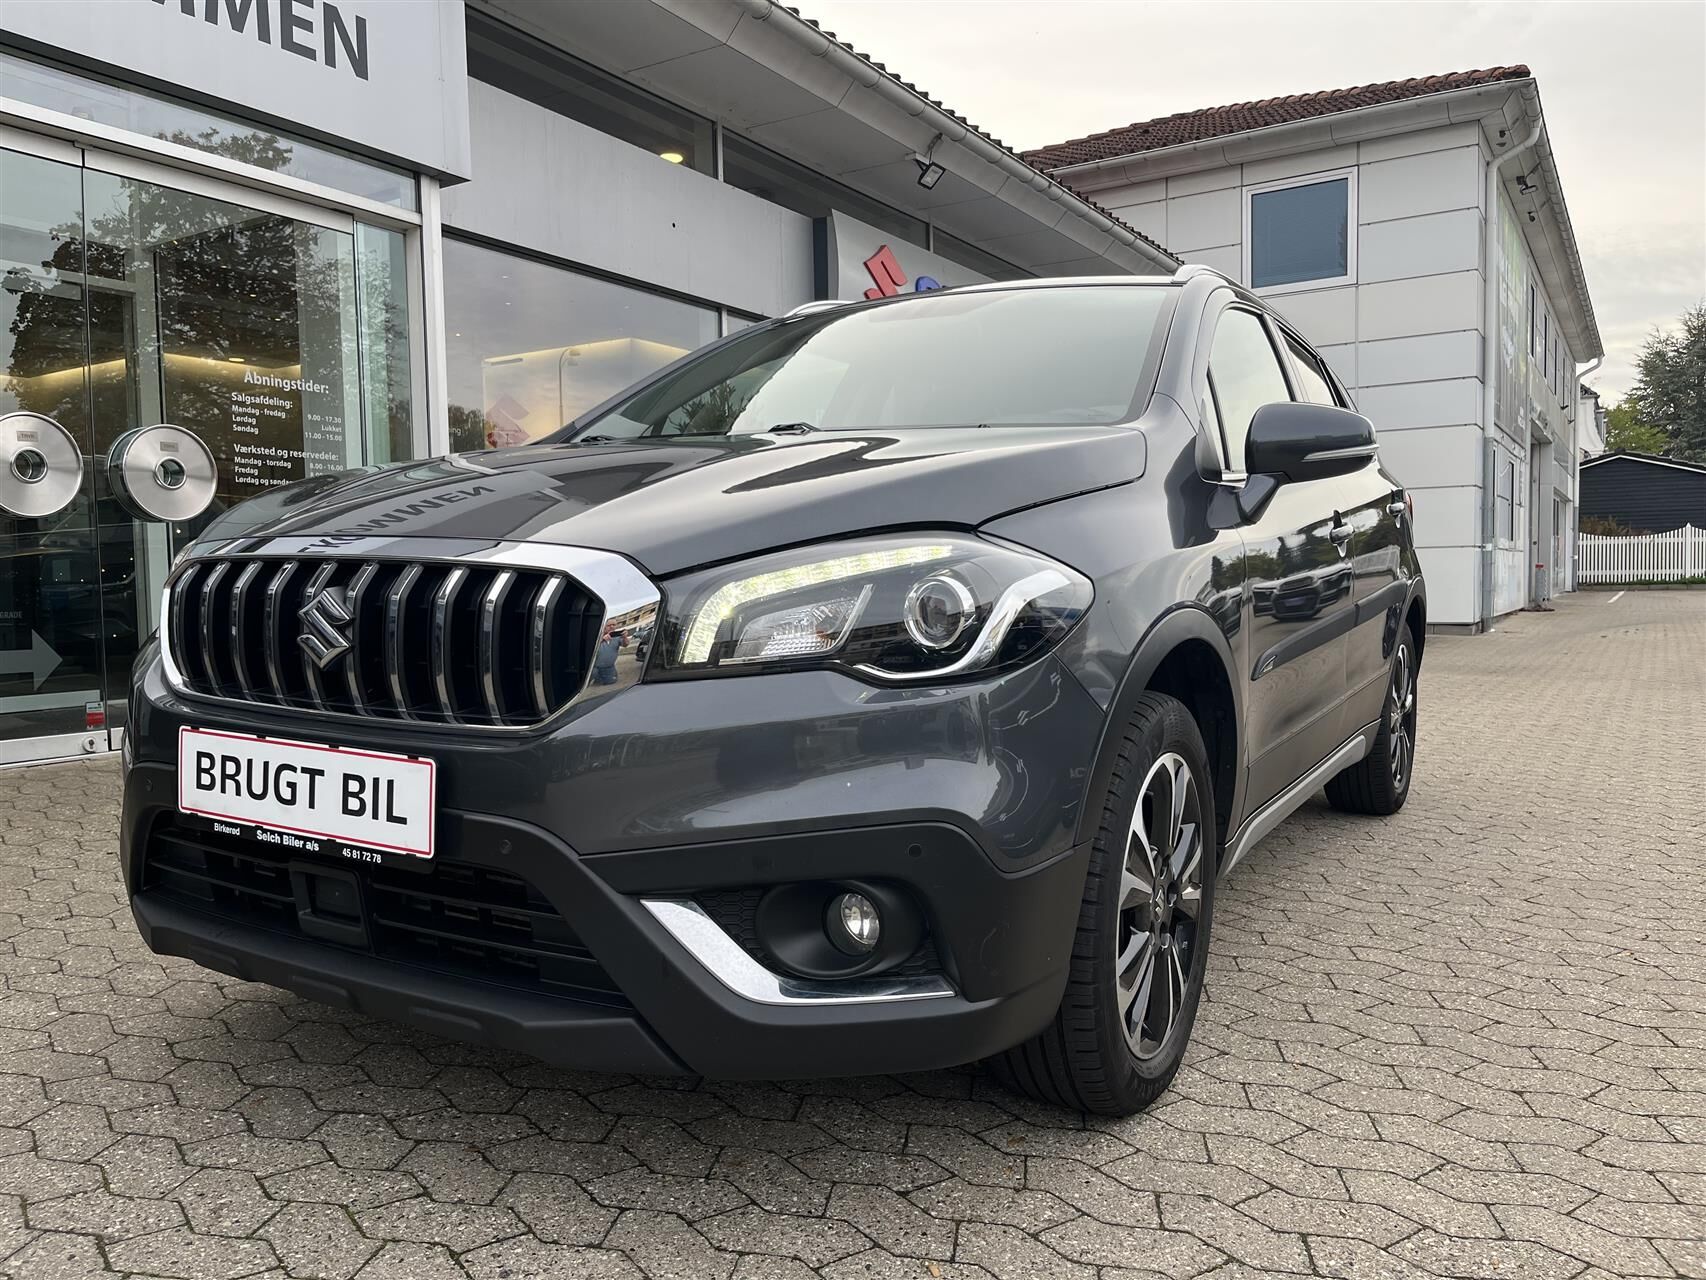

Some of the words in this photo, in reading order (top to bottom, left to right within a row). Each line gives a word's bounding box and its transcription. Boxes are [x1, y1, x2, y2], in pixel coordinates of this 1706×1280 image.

[244, 368, 329, 394] Åbningstider:
[231, 392, 293, 409] Salgsafdeling:
[232, 405, 259, 416] Mandag
[264, 408, 286, 418] fredag
[321, 424, 342, 433] Lukket
[234, 444, 276, 456] Værksted
[277, 449, 288, 458] og
[289, 450, 339, 461] reservedele:
[234, 457, 262, 466] Mandag
[267, 460, 292, 469] torsdag
[235, 466, 259, 475] Fredag
[260, 478, 268, 486] og
[196, 750, 325, 810] BRUGT
[341, 772, 408, 825] BIL
[213, 822, 241, 836] Birkerød
[256, 830, 281, 845] Selch
[282, 835, 304, 848] Biler
[305, 840, 320, 851] a/s
[342, 847, 351, 858] 45
[352, 849, 361, 859] 81
[362, 851, 372, 861] 72
[372, 853, 382, 863] 78
